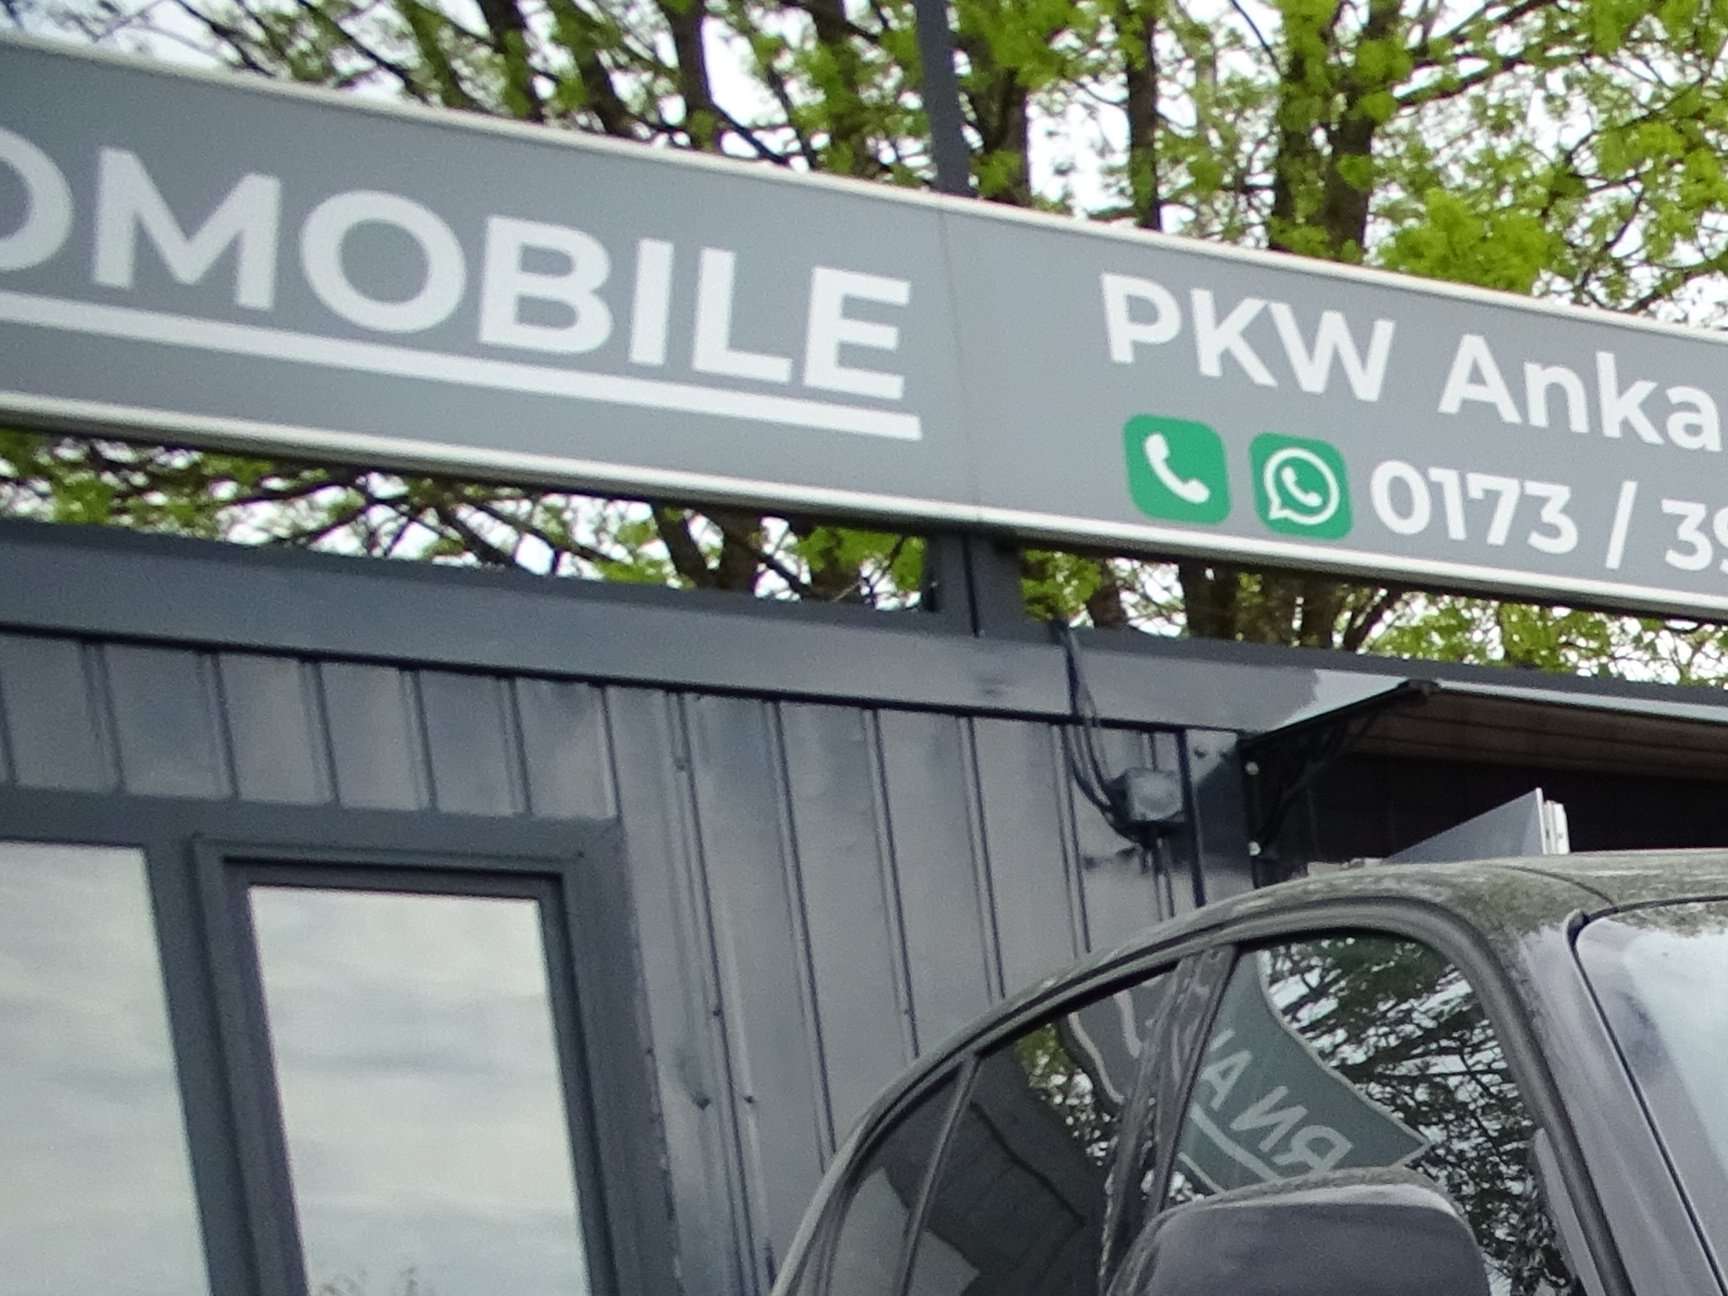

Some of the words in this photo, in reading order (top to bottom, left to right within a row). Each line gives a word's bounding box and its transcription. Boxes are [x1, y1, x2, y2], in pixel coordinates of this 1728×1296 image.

[1100, 273, 1396, 401] PKW
[1370, 460, 1578, 554] 0173
[1605, 480, 1639, 569] /
